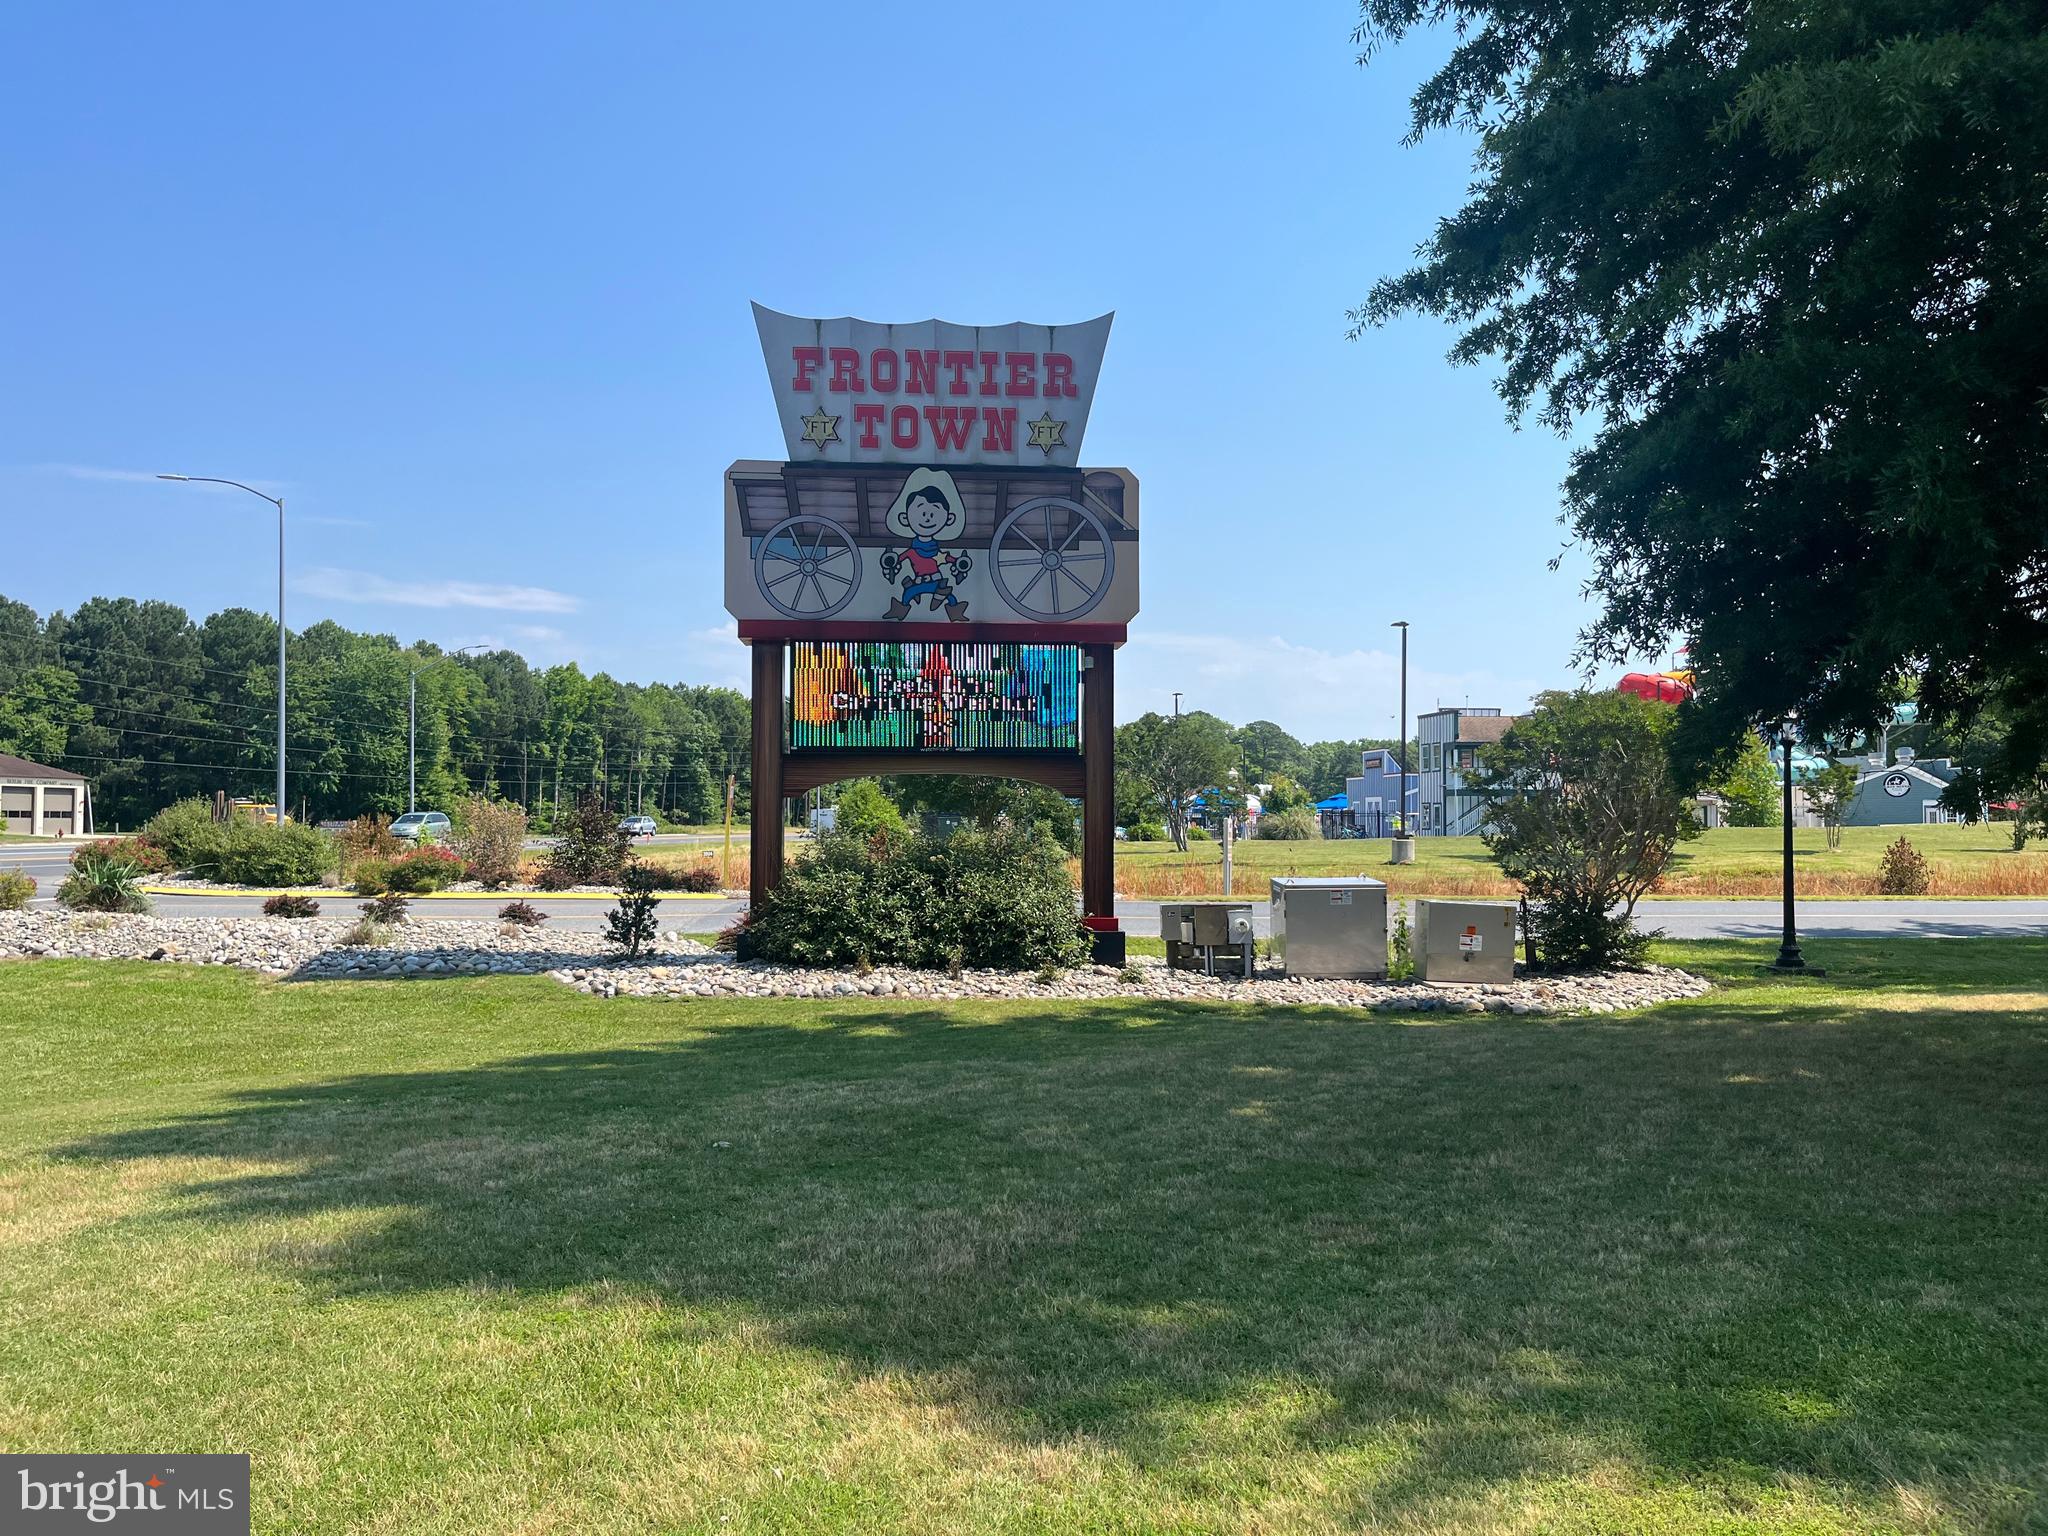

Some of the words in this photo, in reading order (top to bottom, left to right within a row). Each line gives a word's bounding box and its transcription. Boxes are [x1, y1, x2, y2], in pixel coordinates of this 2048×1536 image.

[792, 346, 1077, 398] FRONTIER
[811, 421, 829, 433] FT
[854, 404, 1017, 451] TOWN
[1037, 426, 1055, 438] FT
